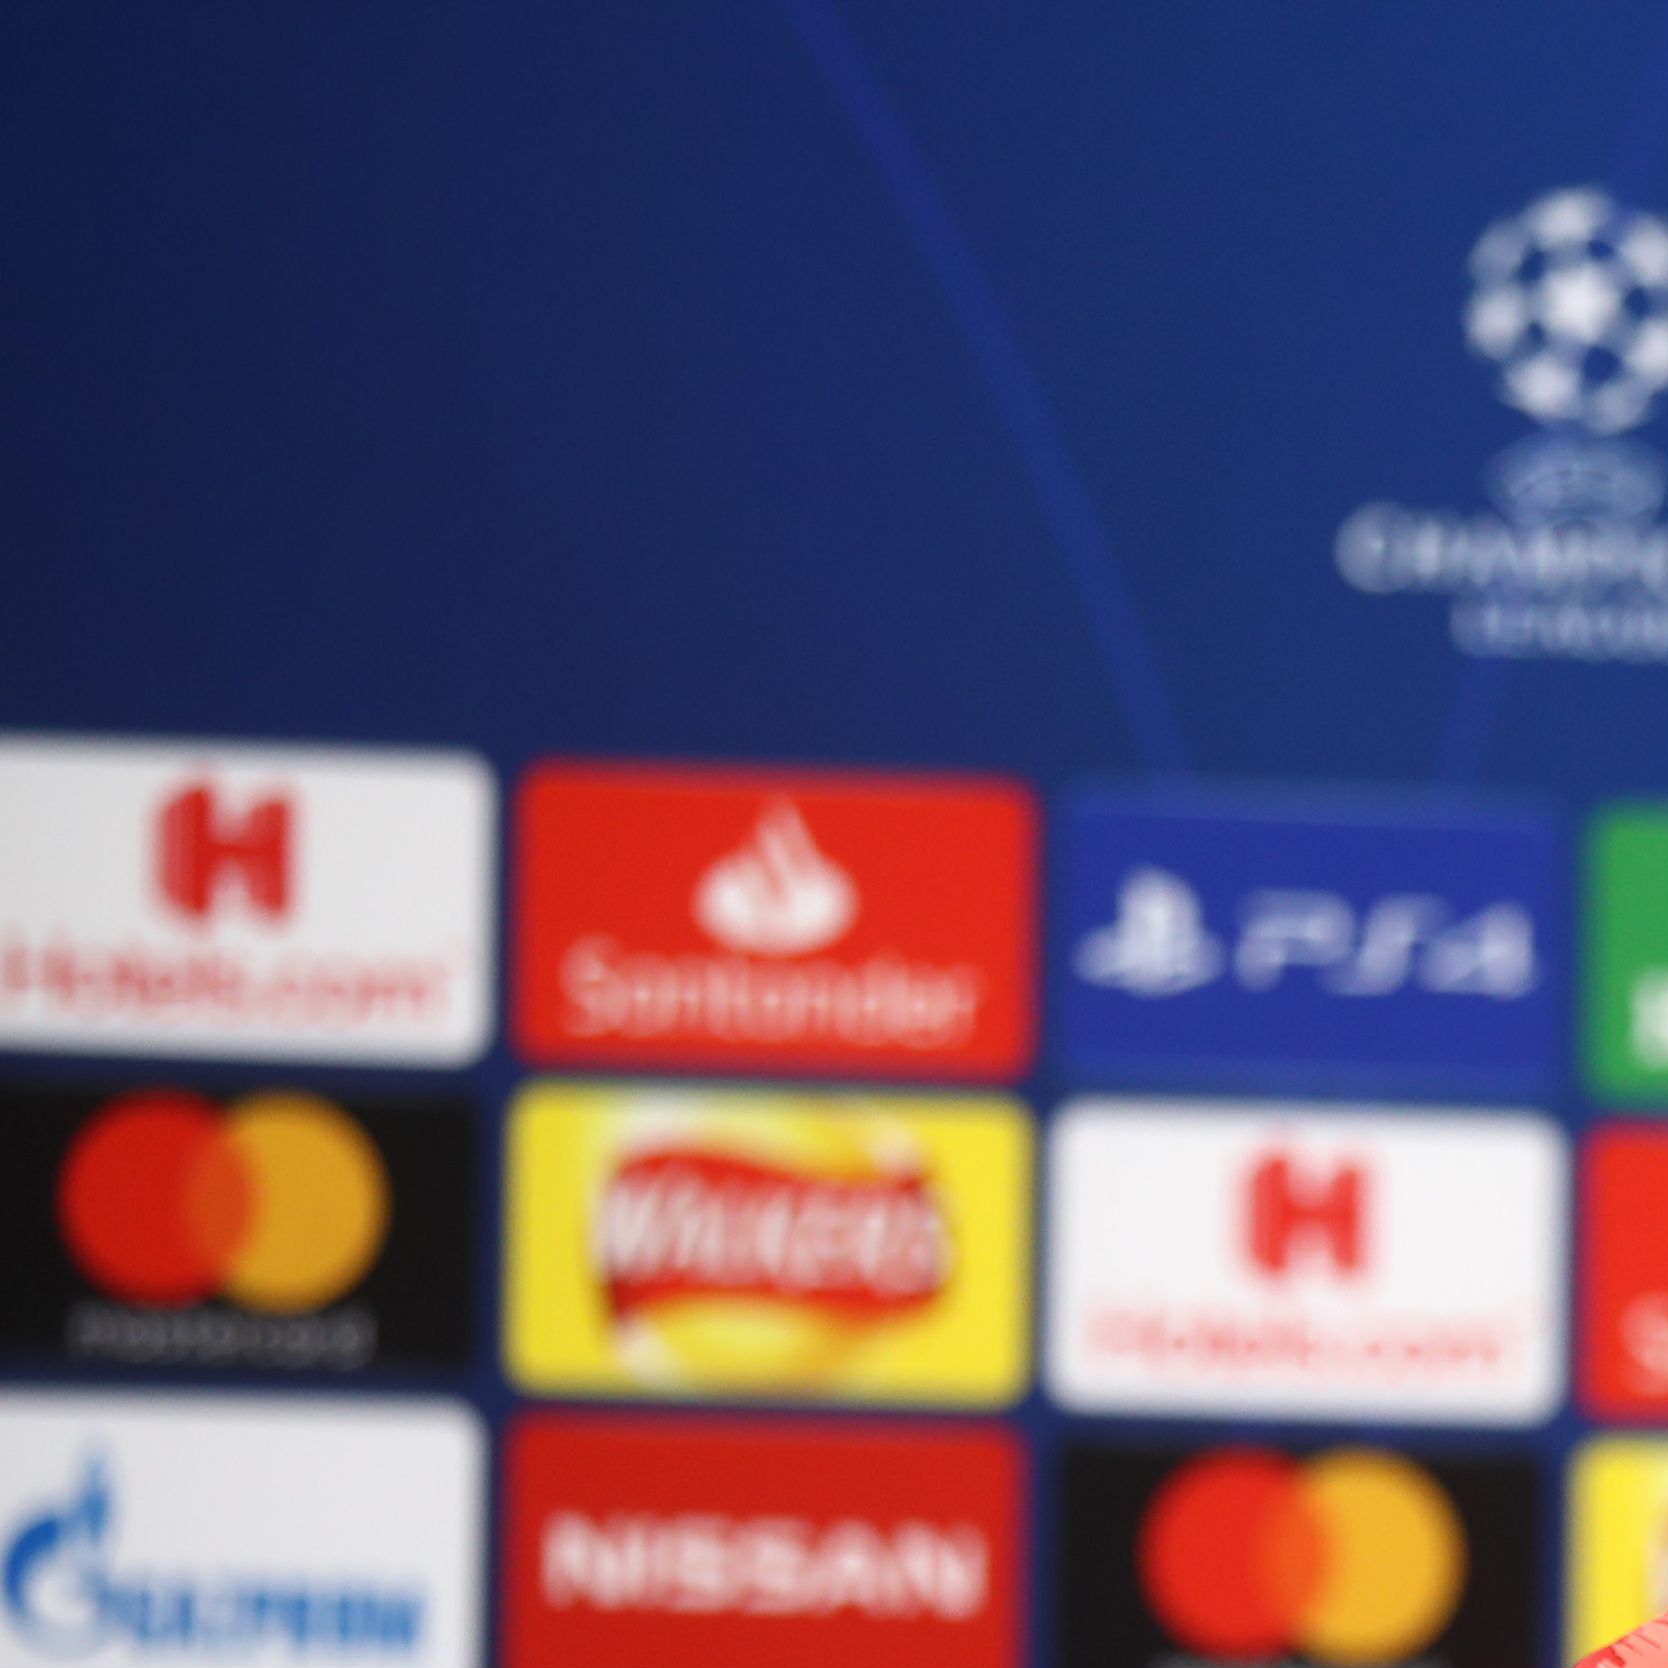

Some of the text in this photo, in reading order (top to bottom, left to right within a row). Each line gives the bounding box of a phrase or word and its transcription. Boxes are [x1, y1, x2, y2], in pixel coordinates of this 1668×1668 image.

[564, 942, 974, 1040] Santander
[1236, 890, 1534, 1000] PS4
[540, 1512, 988, 1618] NISSAN
